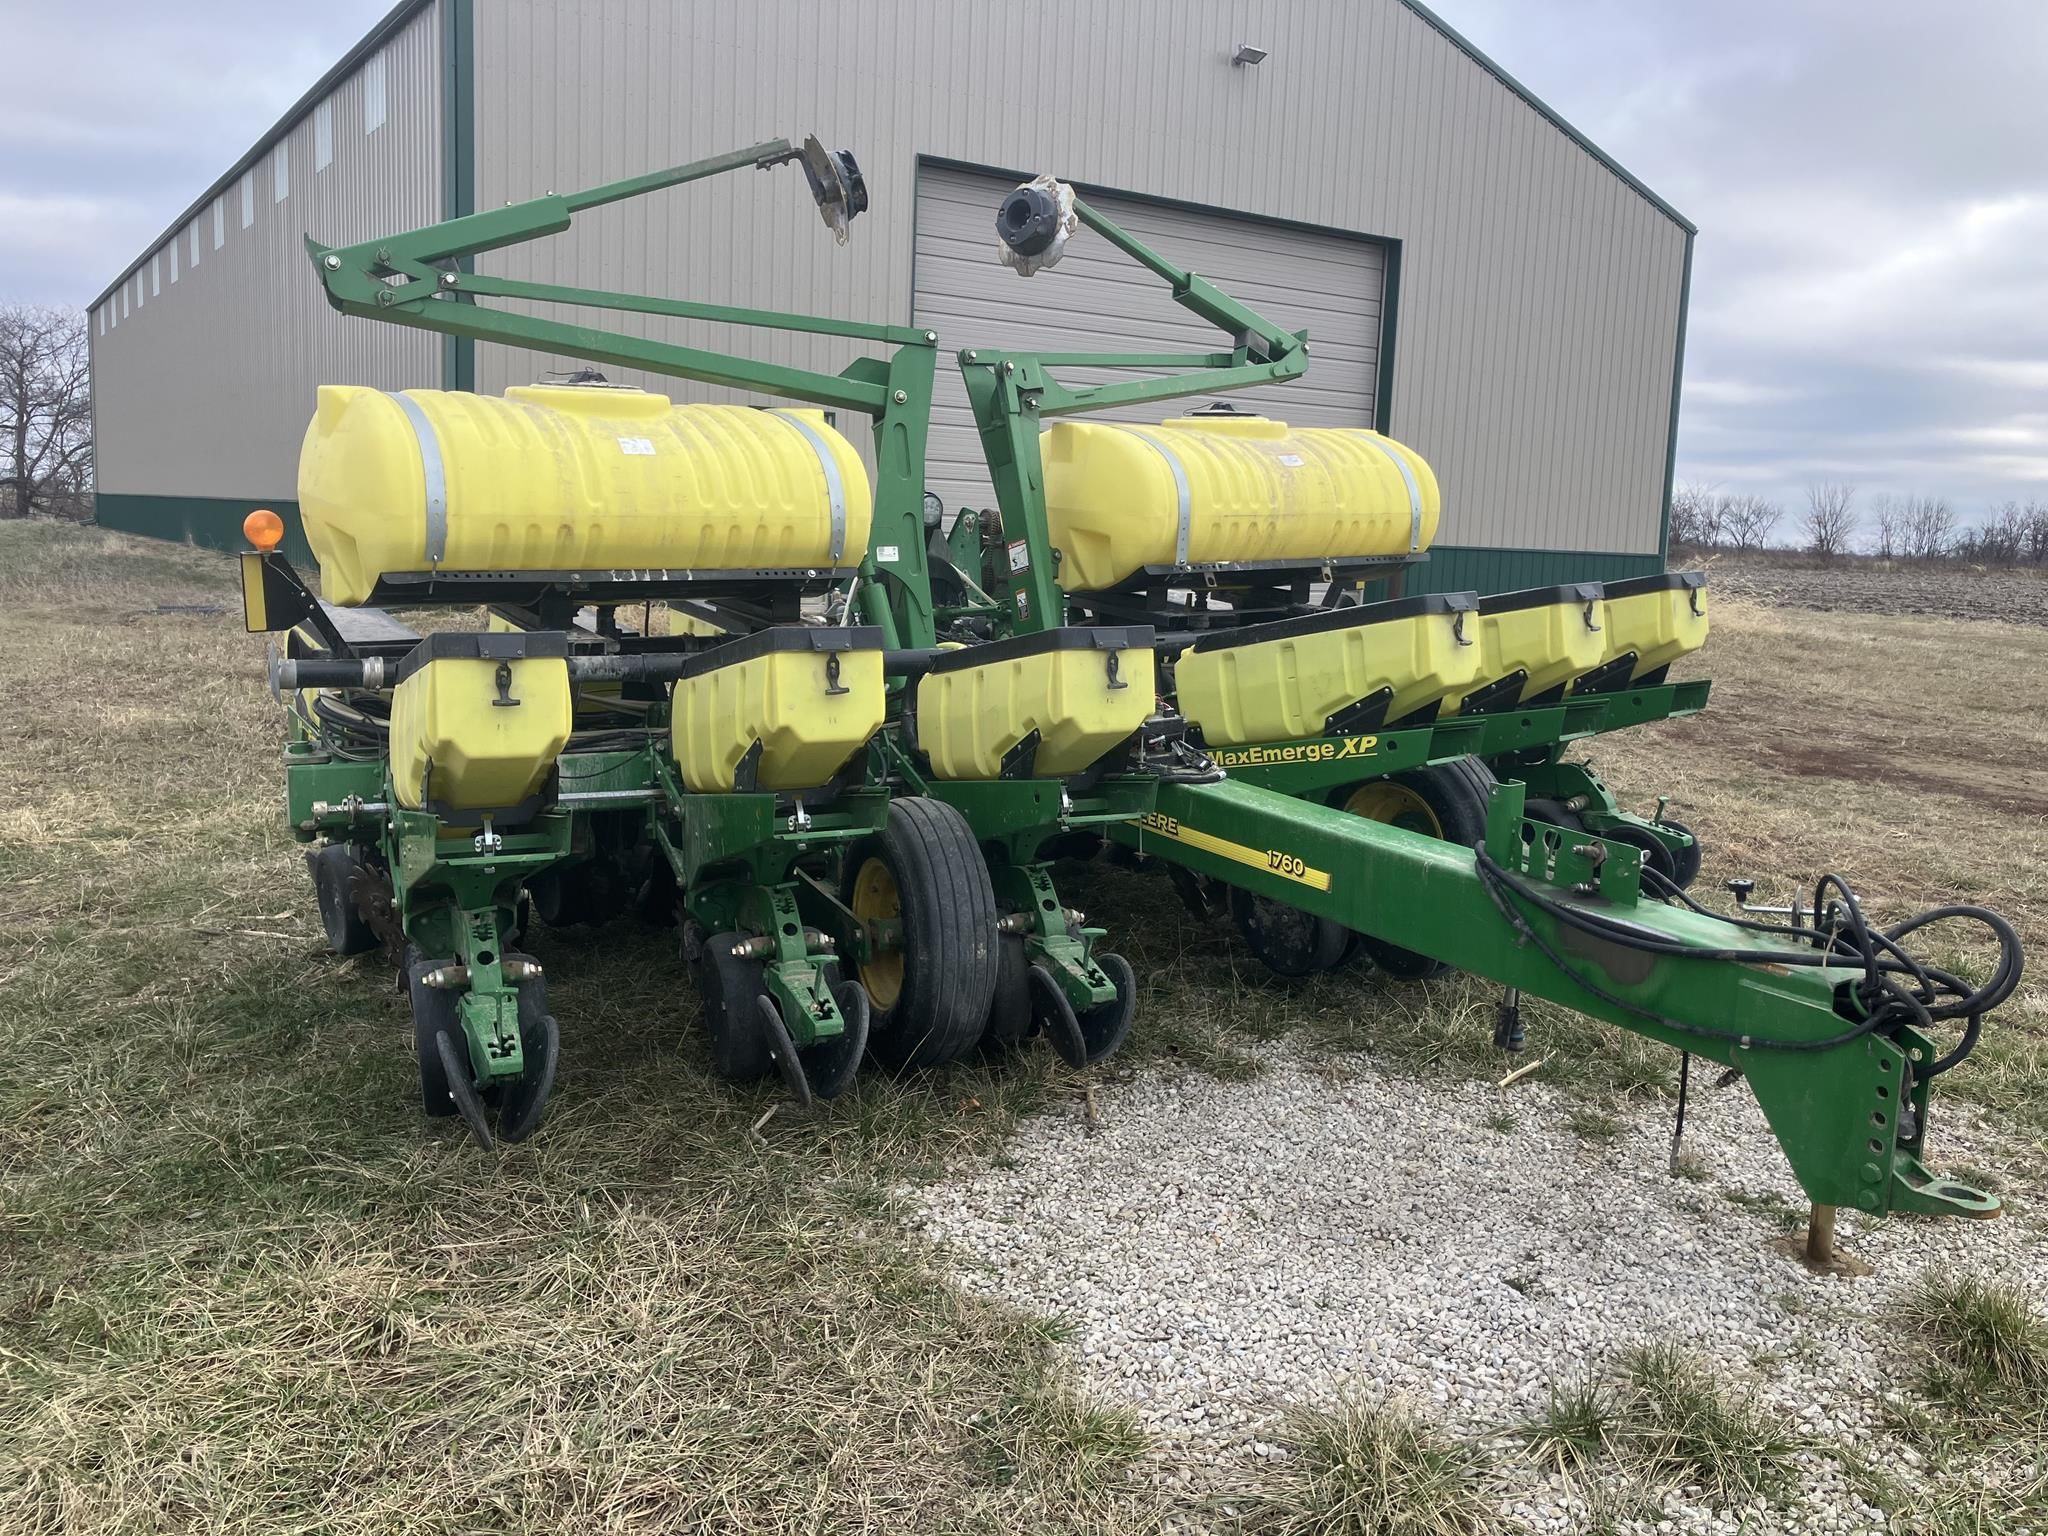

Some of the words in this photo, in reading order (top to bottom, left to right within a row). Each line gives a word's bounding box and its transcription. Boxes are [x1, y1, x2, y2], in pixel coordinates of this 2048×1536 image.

[1207, 743, 1334, 766] MaxEmerge
[1335, 735, 1378, 759] XP
[1266, 849, 1305, 877] 1760
